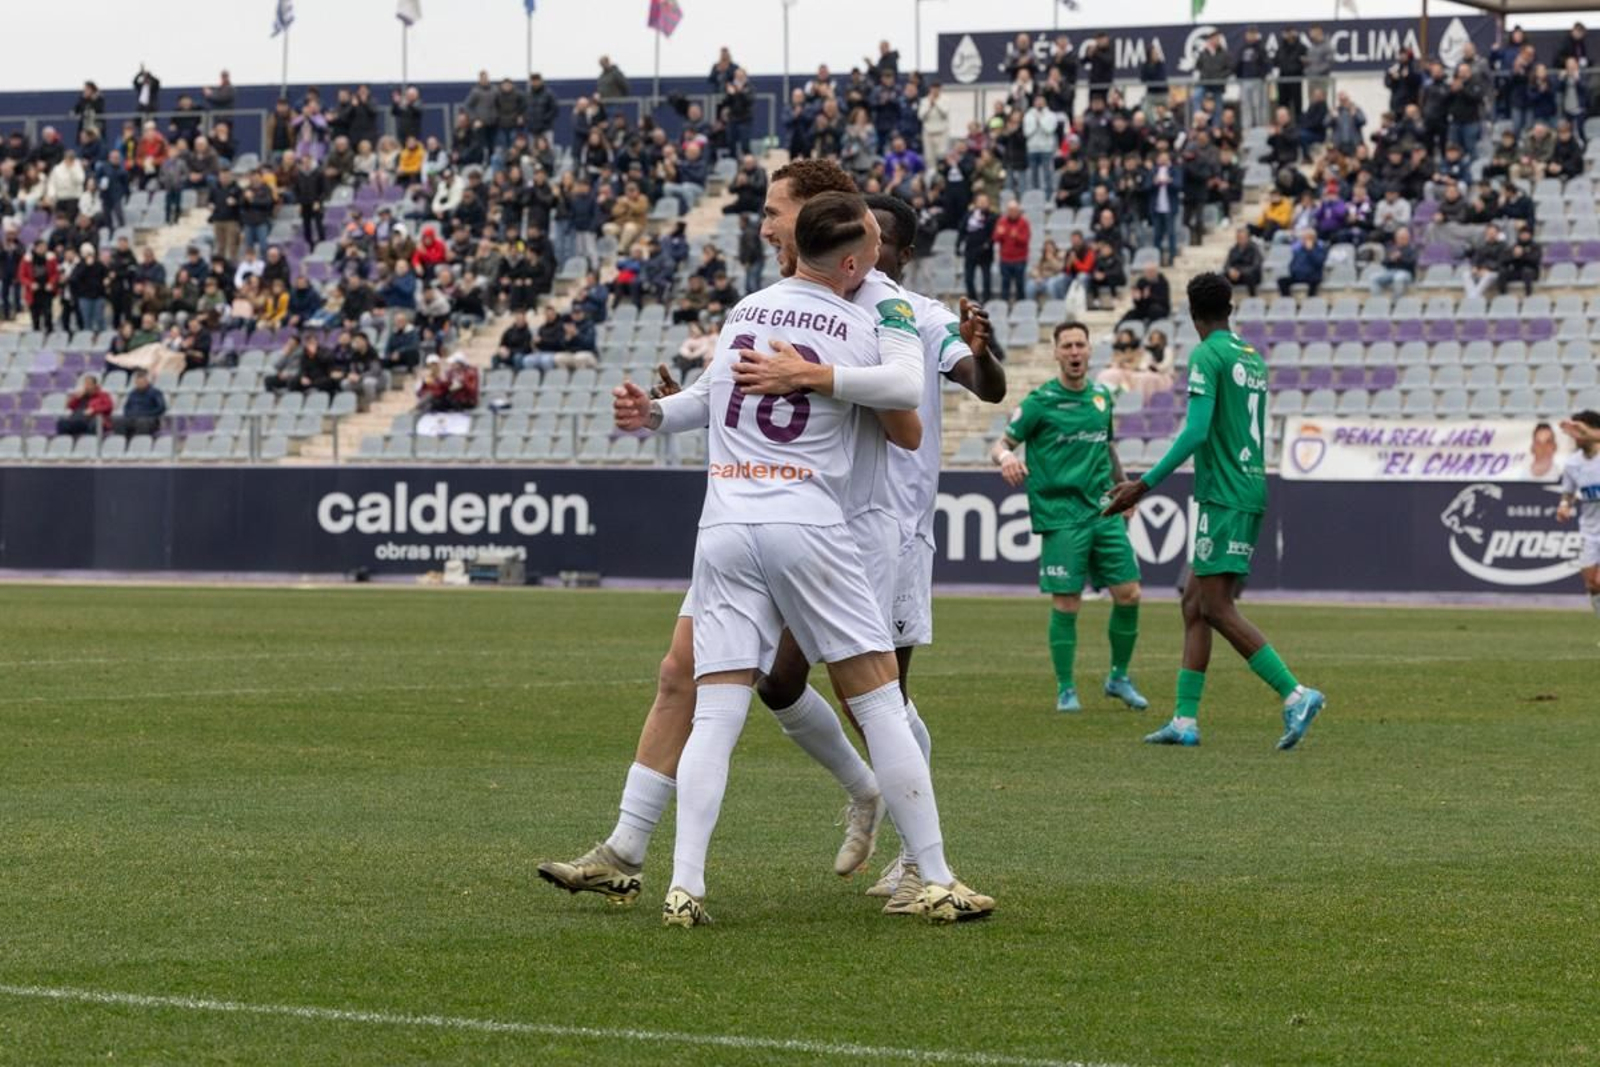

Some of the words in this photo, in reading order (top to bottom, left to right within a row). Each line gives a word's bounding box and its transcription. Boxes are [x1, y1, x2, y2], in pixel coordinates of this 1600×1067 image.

[770, 308, 848, 341] GARCÍA
[725, 334, 821, 443] 18
[1386, 427, 1440, 446] REAL
[374, 541, 432, 561] obras
